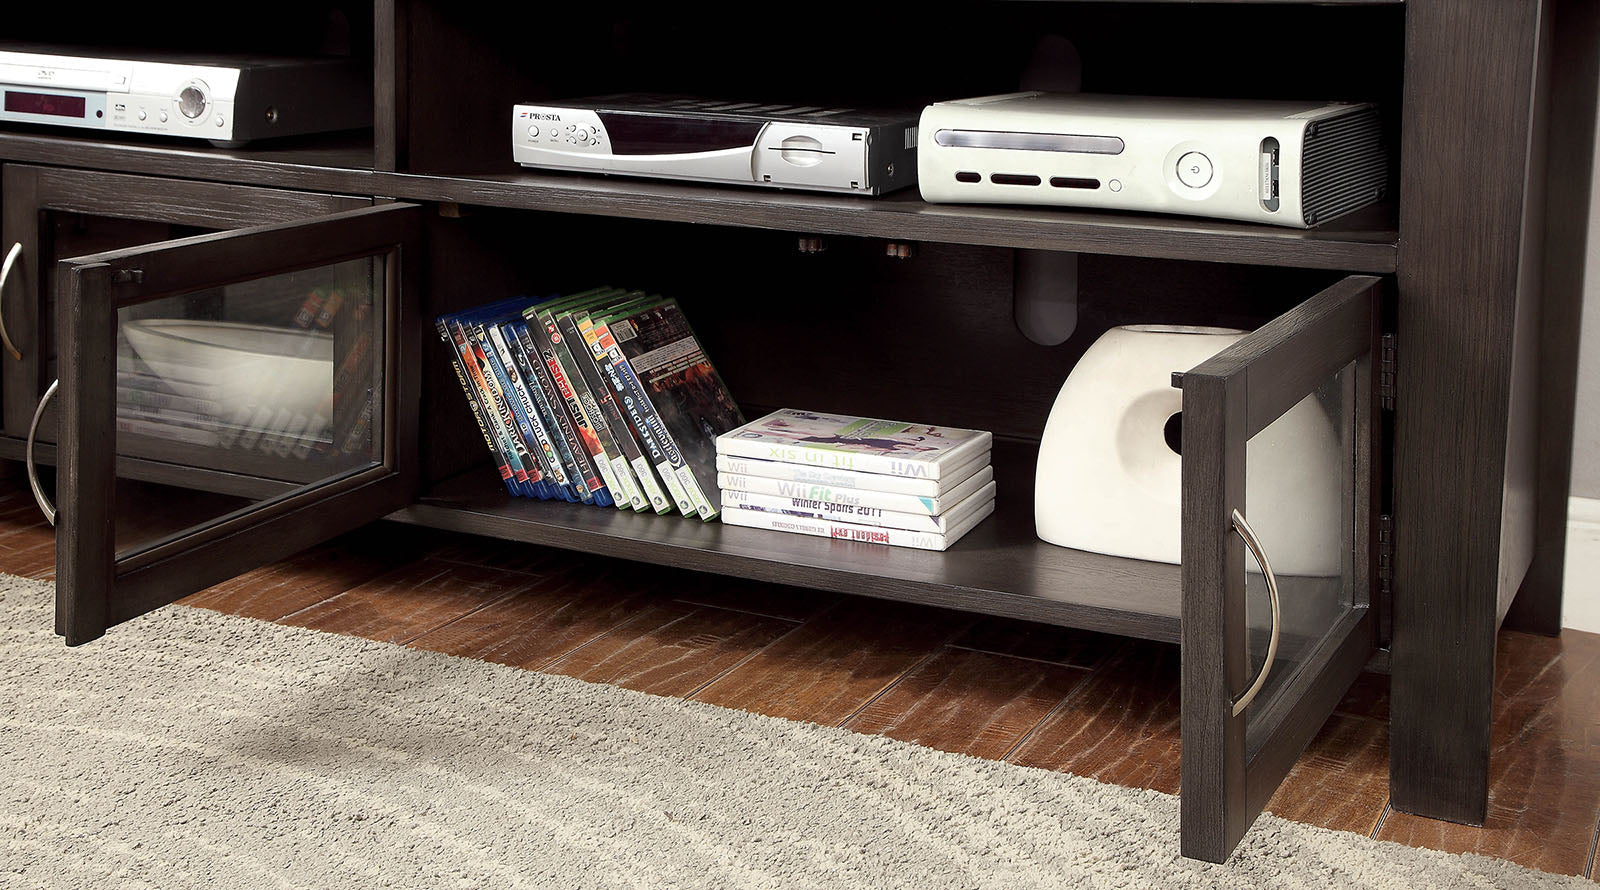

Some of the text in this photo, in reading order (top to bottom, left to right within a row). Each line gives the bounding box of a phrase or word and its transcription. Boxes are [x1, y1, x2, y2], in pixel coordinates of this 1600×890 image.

[532, 359, 557, 410] SWORD
[480, 389, 489, 405] Crack
[516, 385, 533, 414] CHUCK
[530, 415, 544, 438] LUCK
[624, 395, 661, 459] DARKSIDERS
[501, 436, 514, 460] Ratchet
[506, 423, 528, 455] DARK
[556, 413, 591, 475] HEAVENLY
[727, 461, 748, 474] Wii
[768, 447, 928, 477] Wii fit in six
[726, 475, 746, 489] Wii
[728, 490, 748, 502] Wii
[834, 492, 860, 506] Plus
